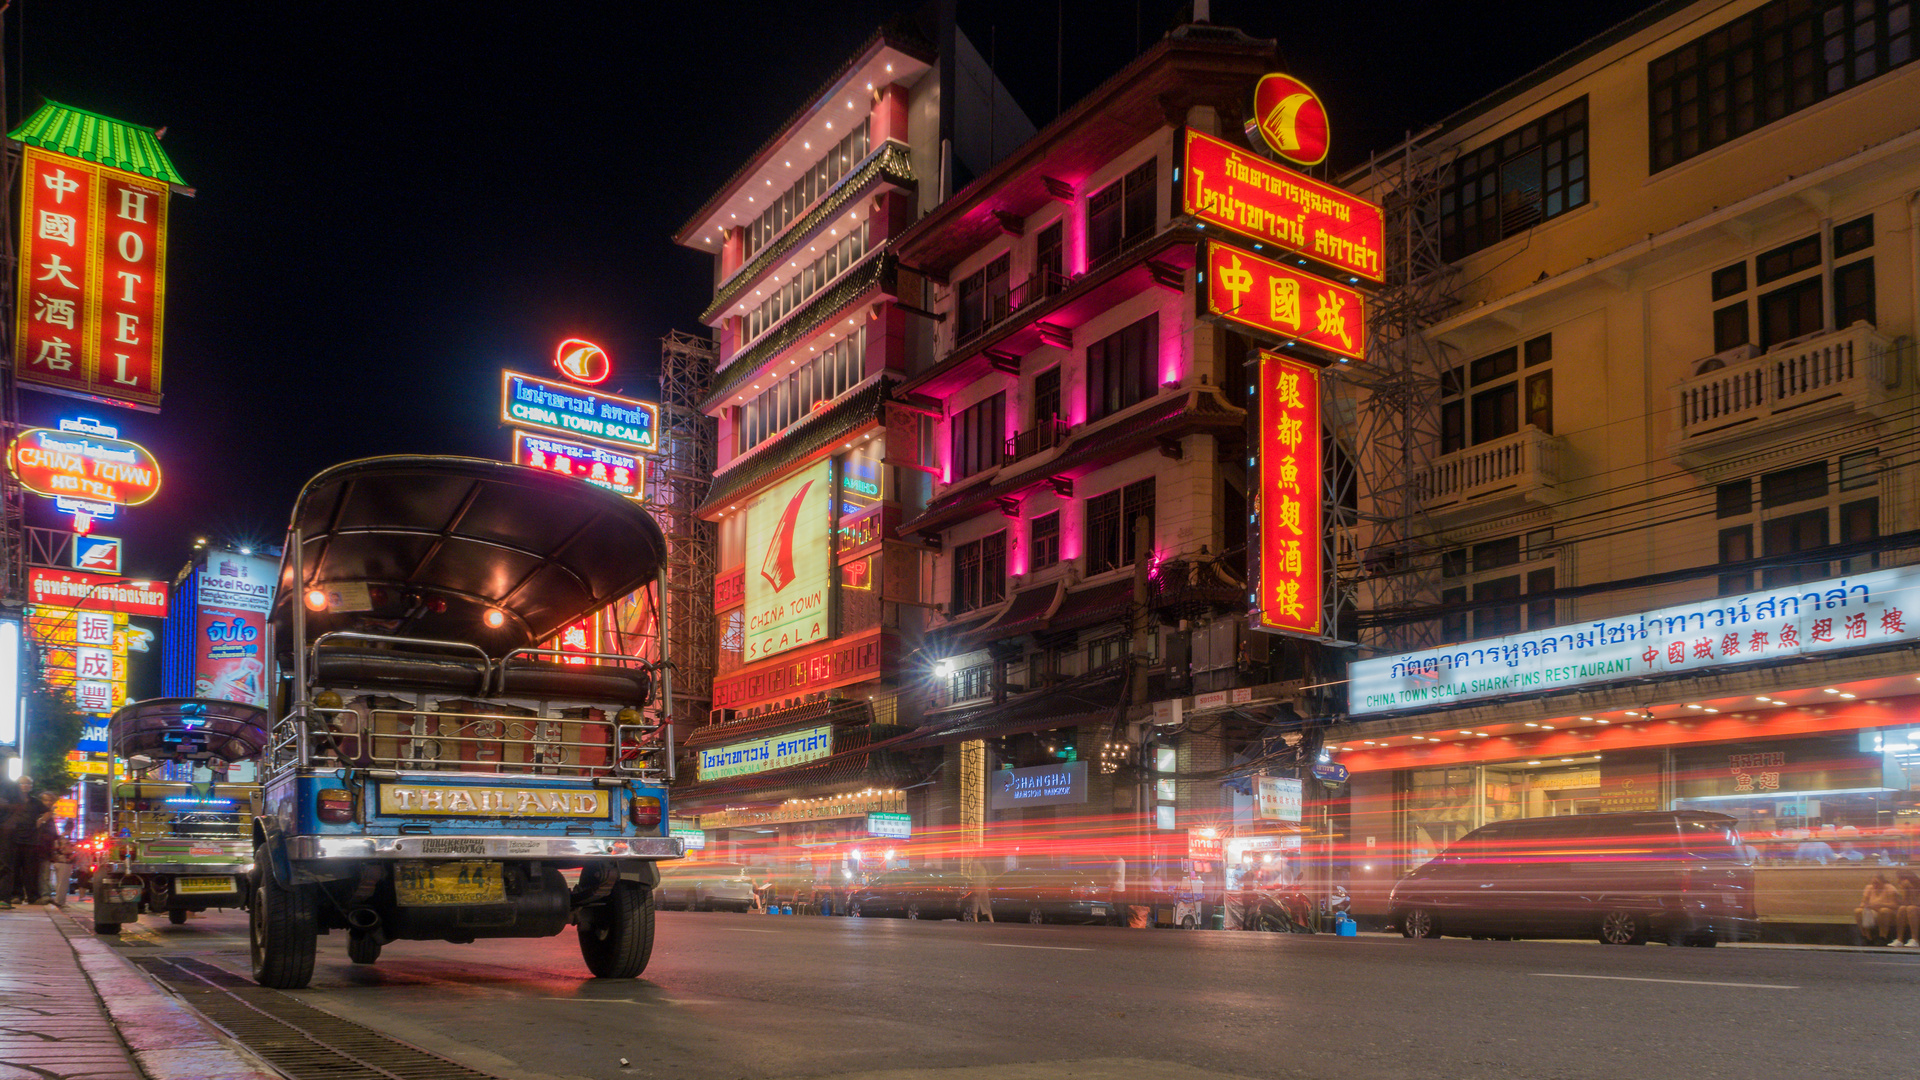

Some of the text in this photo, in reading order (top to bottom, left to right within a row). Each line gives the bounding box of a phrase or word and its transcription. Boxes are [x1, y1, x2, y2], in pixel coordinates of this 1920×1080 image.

[32, 169, 80, 372] 中國大酒店
[113, 188, 148, 386] HOTEL
[1219, 254, 1352, 350] 中國城
[512, 404, 651, 444] CHINA TOWN SCALA
[18, 448, 152, 487] CHINA TOWN
[1275, 371, 1305, 622] 銀都魚翅酒樓
[201, 576, 268, 595] Hotel Royal
[750, 590, 822, 630] CHINA TOWN
[206, 618, 258, 642] จับใจ
[750, 622, 821, 658] SCALA
[1642, 607, 1907, 669] 中國城銀都魚翅酒樓
[1366, 657, 1633, 708] CHINA TOWN SCALA SHARK-FINS RESTAURANT
[702, 728, 828, 769] ไชน่าทาวน์ สกาล่า
[700, 764, 760, 780] CHINA TOWN SCALA
[1015, 772, 1071, 790] SHANGHAI
[1339, 768, 1345, 778] 2
[1735, 771, 1780, 791] 魚翅
[394, 788, 599, 815] THAILAND
[1014, 786, 1071, 799] MANSION BANGKOK
